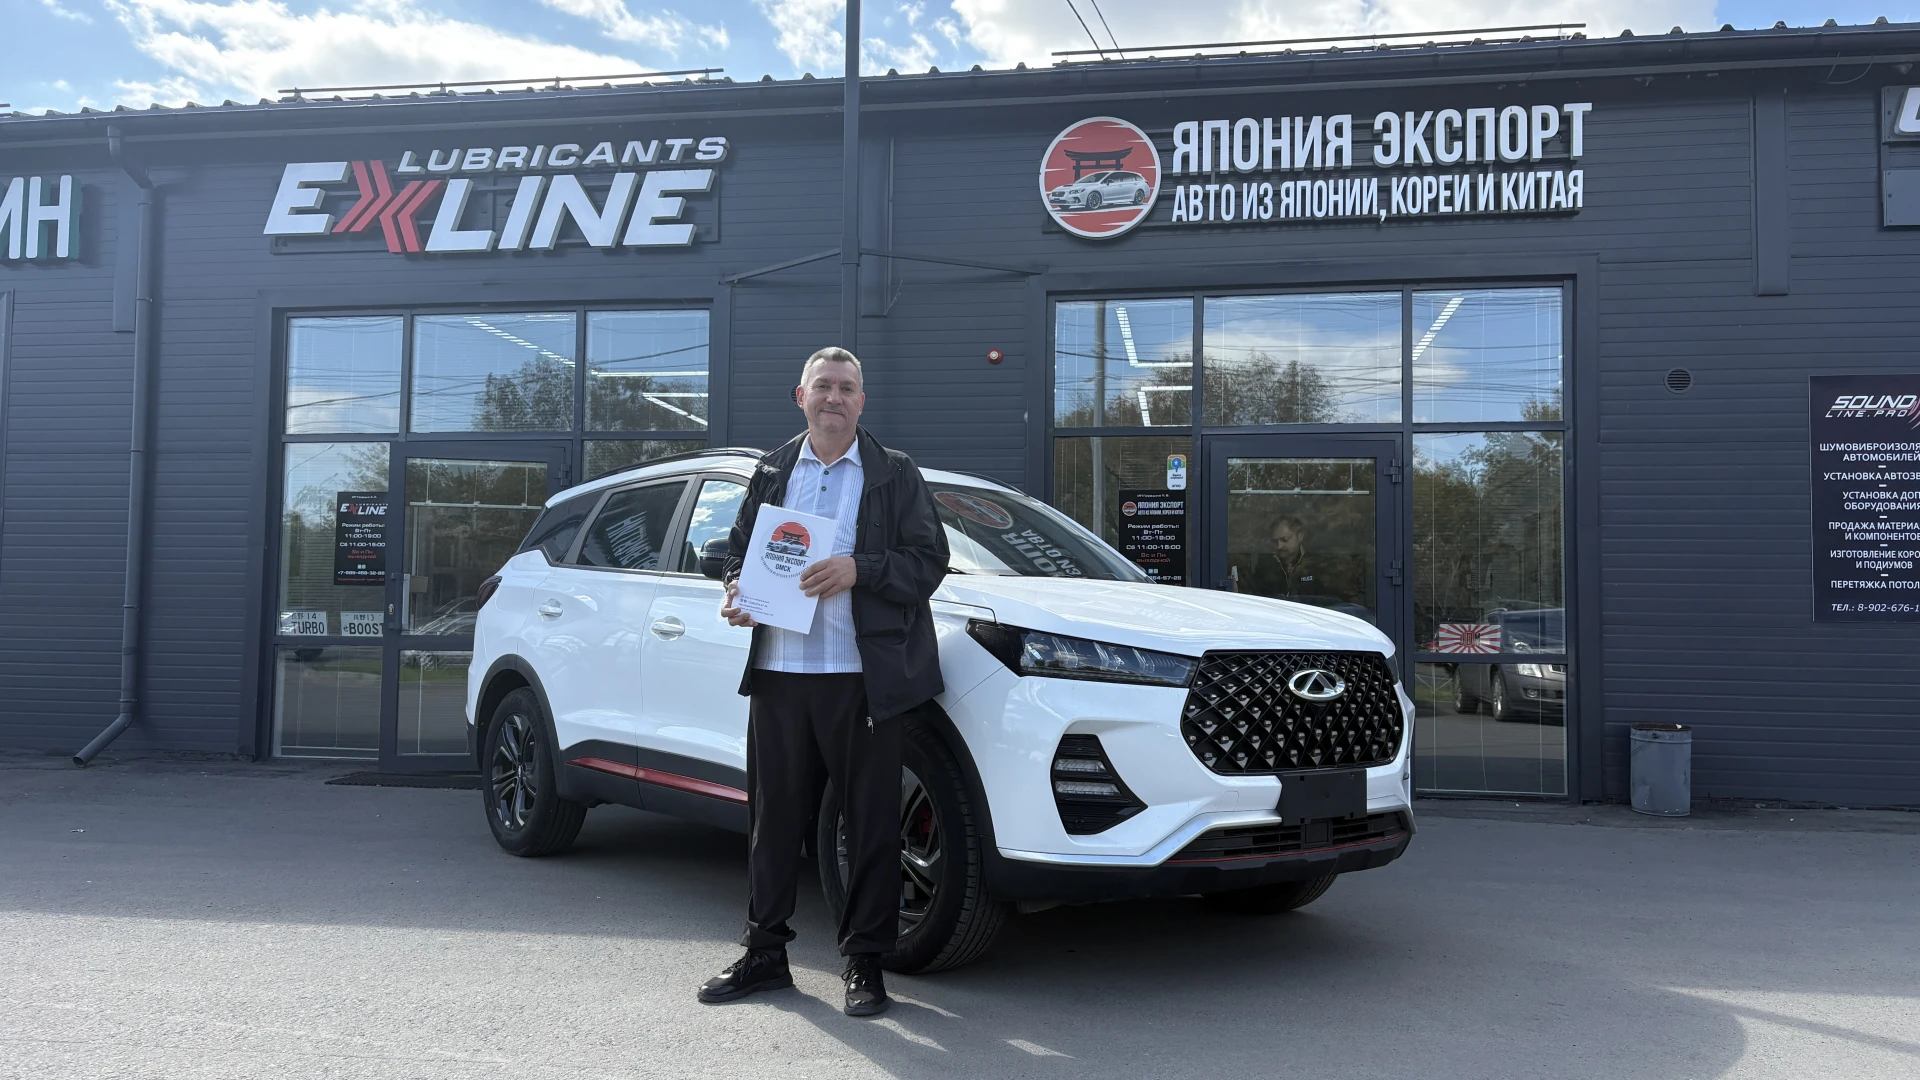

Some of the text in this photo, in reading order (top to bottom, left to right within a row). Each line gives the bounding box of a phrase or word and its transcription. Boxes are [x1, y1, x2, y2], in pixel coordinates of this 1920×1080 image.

[1171, 102, 1593, 175] ЯПОНИЯ ЭКСПОРТ
[397, 136, 729, 174] LUBRICANTS
[1171, 169, 1584, 224] АВТО ИЗ ЯПОНИИ, КОРЕИ И КИТАЯ
[1831, 394, 1917, 409] SOUND
[1825, 409, 1908, 418] LINE.PRO
[1820, 443, 1920, 451] ШУМОВИБРОИЗОЛЯ
[1843, 450, 1920, 461] АВТОМОБИЛЕЙ
[1823, 472, 1882, 480] УСТАНОВКА
[1843, 491, 1899, 500] УСТАНОВКА
[1829, 522, 1920, 531] ПРОДАЖА МАТЕРИА
[1845, 532, 1852, 540] И
[1830, 550, 1920, 559] ИЗГОТОВЛЕНИЕ КОРО
[1856, 561, 1913, 571] И ПОДИУМОВ
[1831, 580, 1887, 589] ПЕРЕТЯЖКА
[1831, 603, 1920, 612] ТЕЛ.: 8-902-676-1
[307, 612, 317, 620] 14
[291, 621, 325, 634] TURBO
